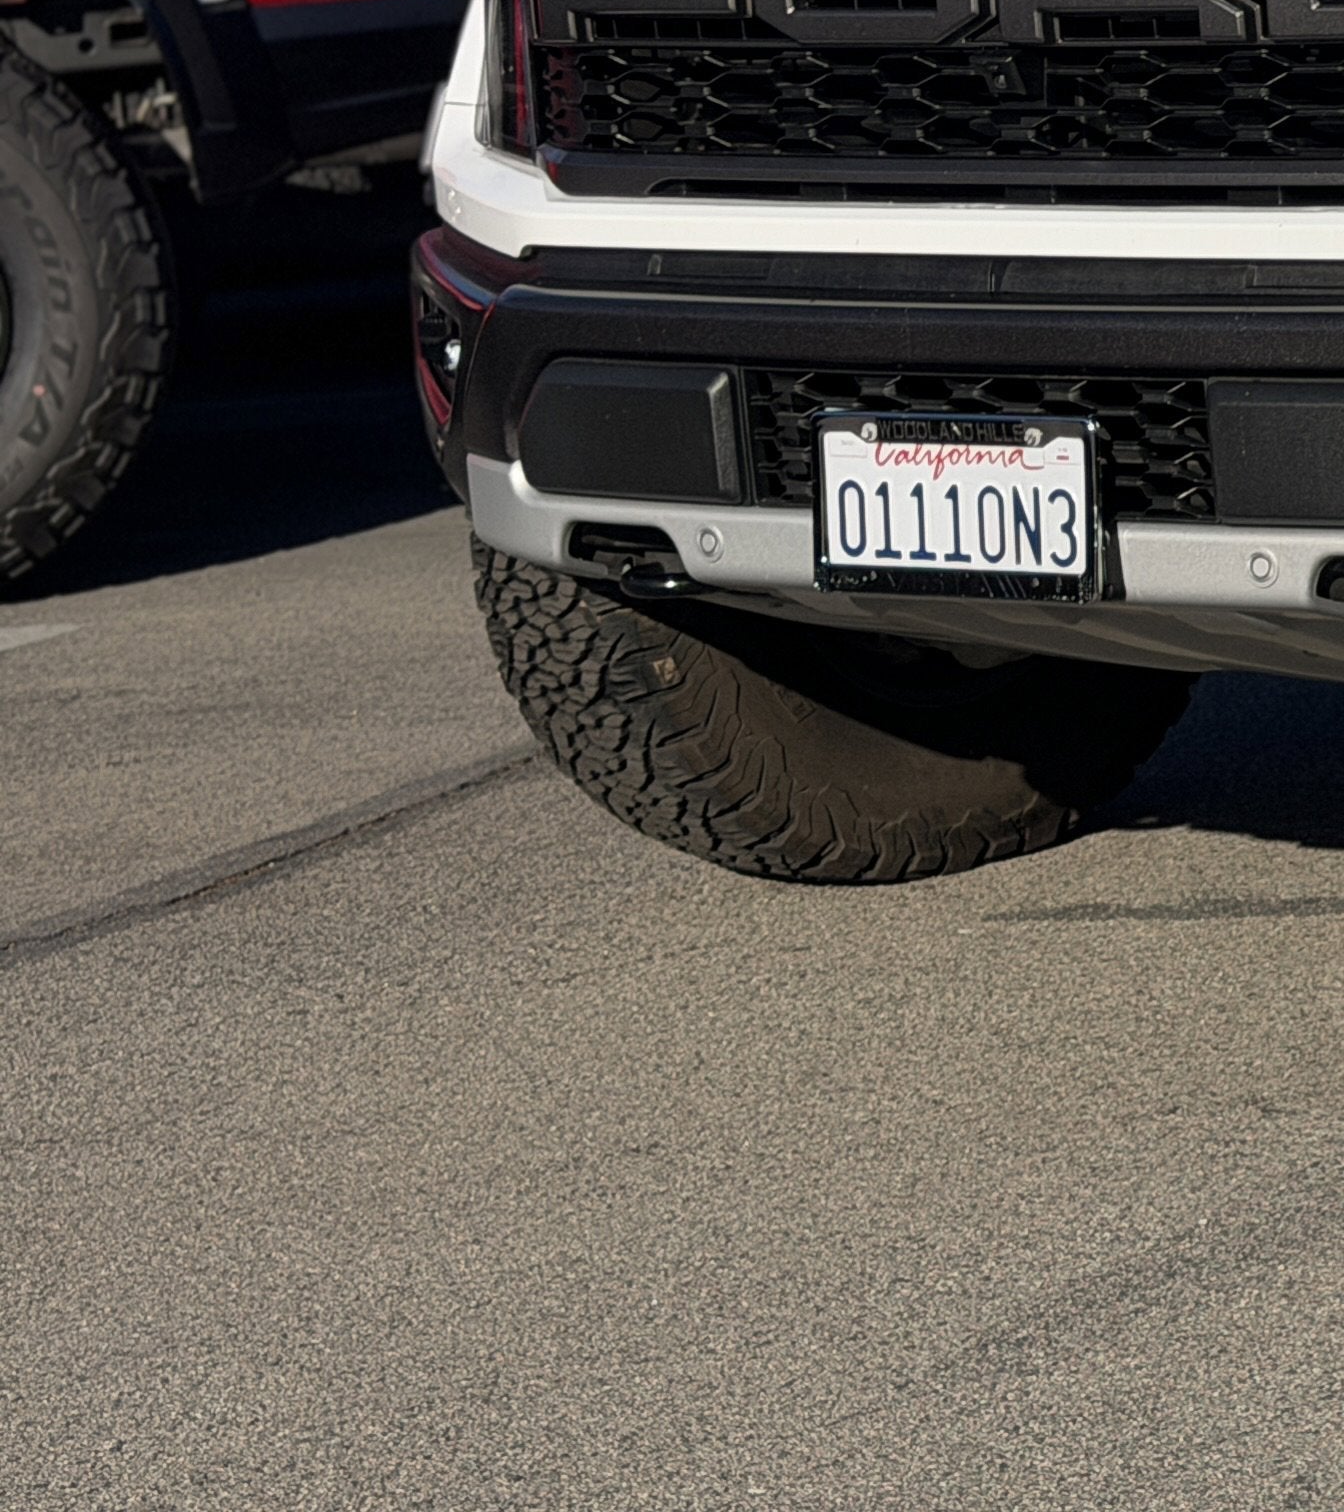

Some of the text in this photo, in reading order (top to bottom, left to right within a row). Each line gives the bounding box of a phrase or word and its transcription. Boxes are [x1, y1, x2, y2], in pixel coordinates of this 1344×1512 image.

[877, 419, 1024, 443] WOODLAND HILLS
[875, 441, 1046, 481] California
[838, 479, 1078, 569] 01110N3
